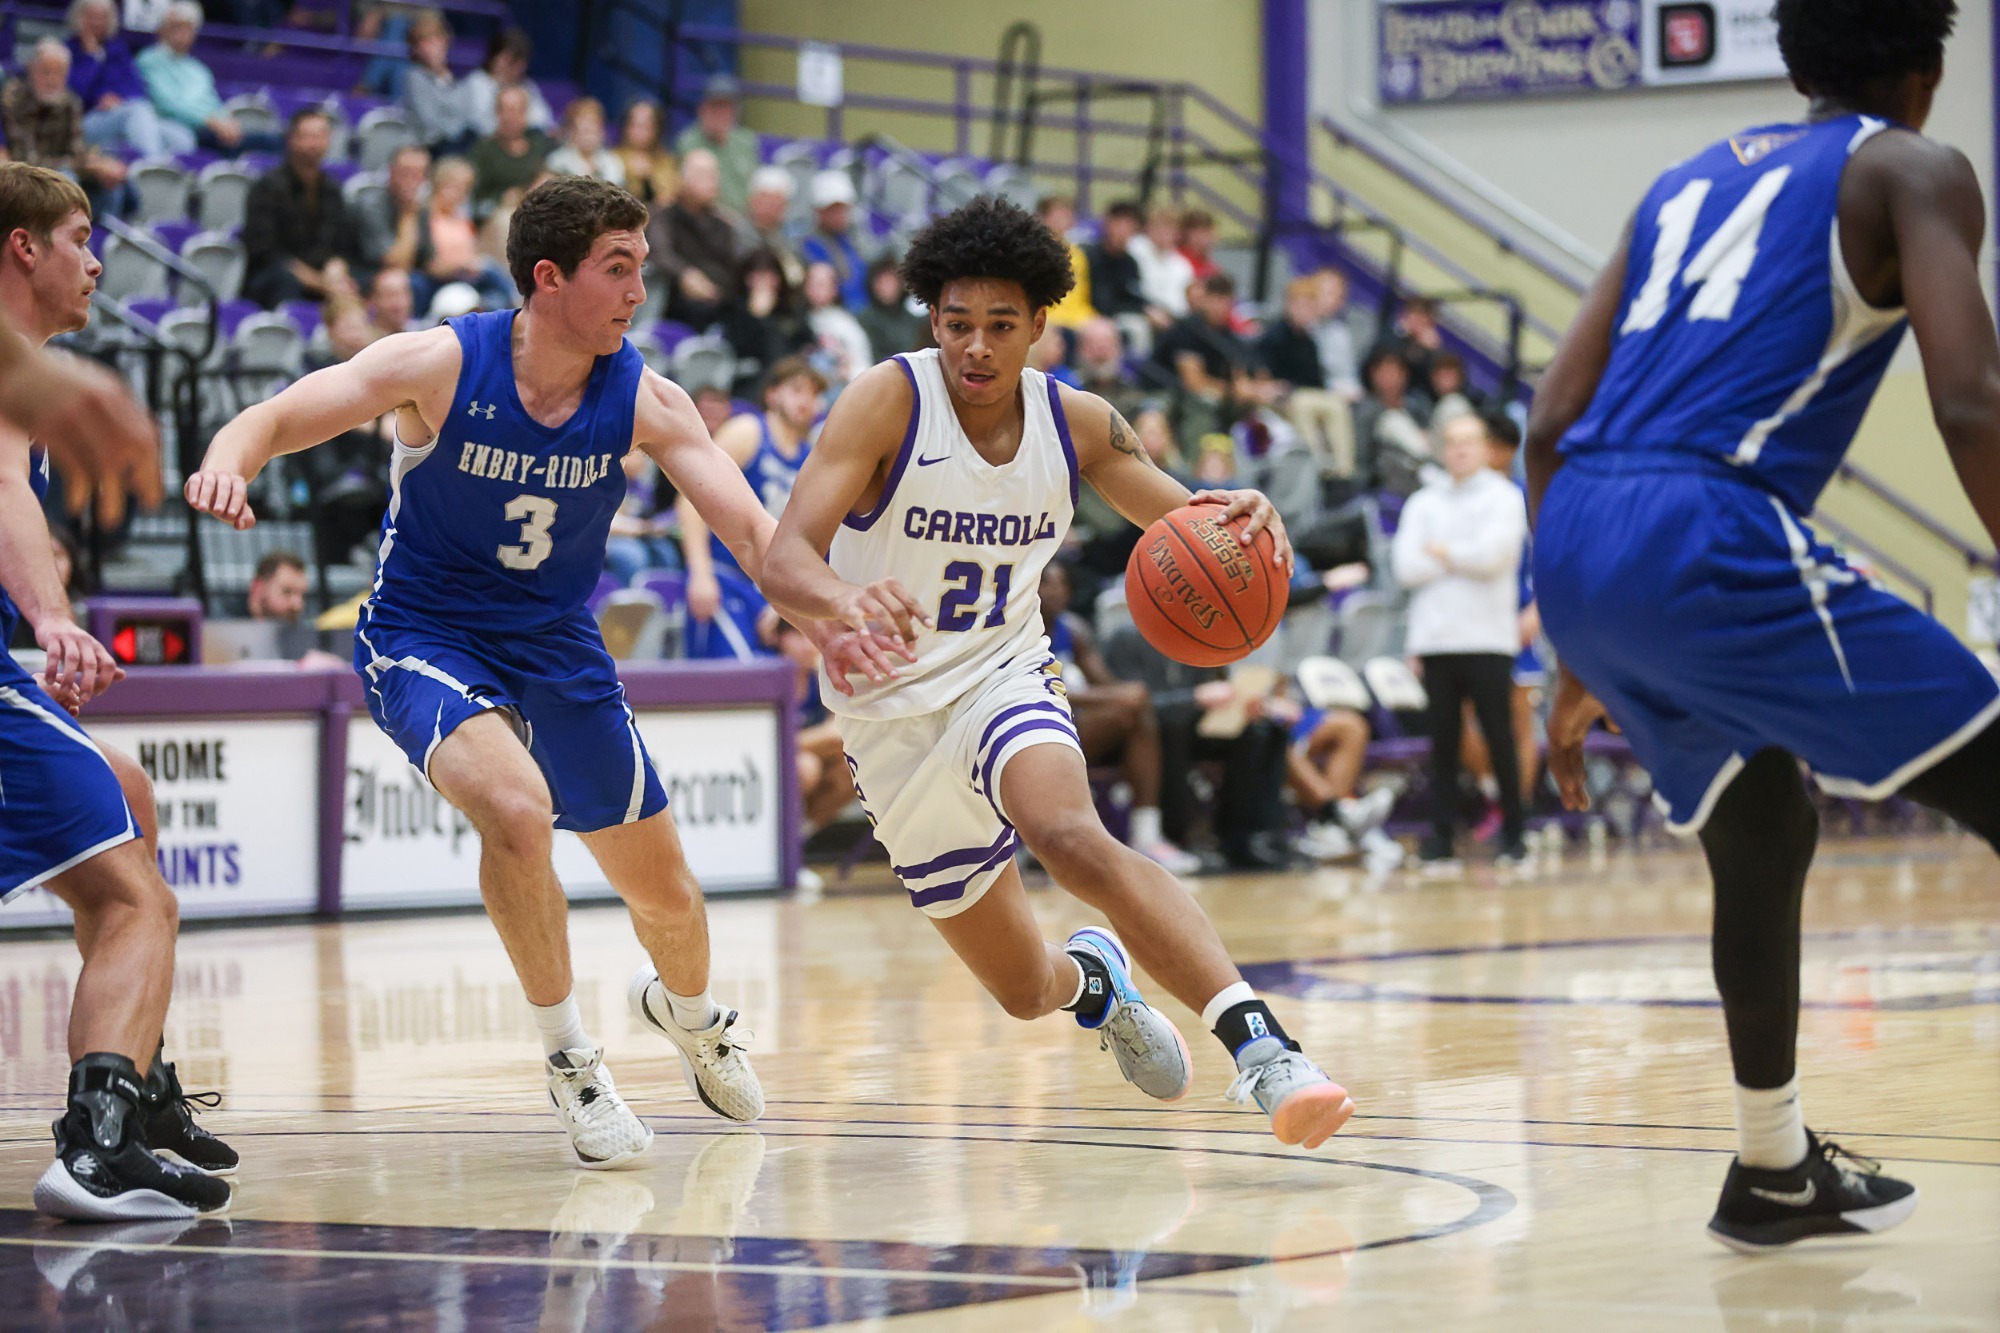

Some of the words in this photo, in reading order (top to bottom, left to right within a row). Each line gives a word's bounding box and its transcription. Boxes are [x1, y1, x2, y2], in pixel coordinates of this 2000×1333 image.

[1620, 164, 1792, 336] 14
[496, 494, 559, 571] 3
[903, 505, 1056, 546] CARROLL
[1186, 519, 1249, 596] LEGACY
[934, 559, 1015, 634] 21
[1146, 534, 1225, 630] SPALDING
[139, 740, 226, 782] HOME
[157, 844, 240, 886] AINTS
